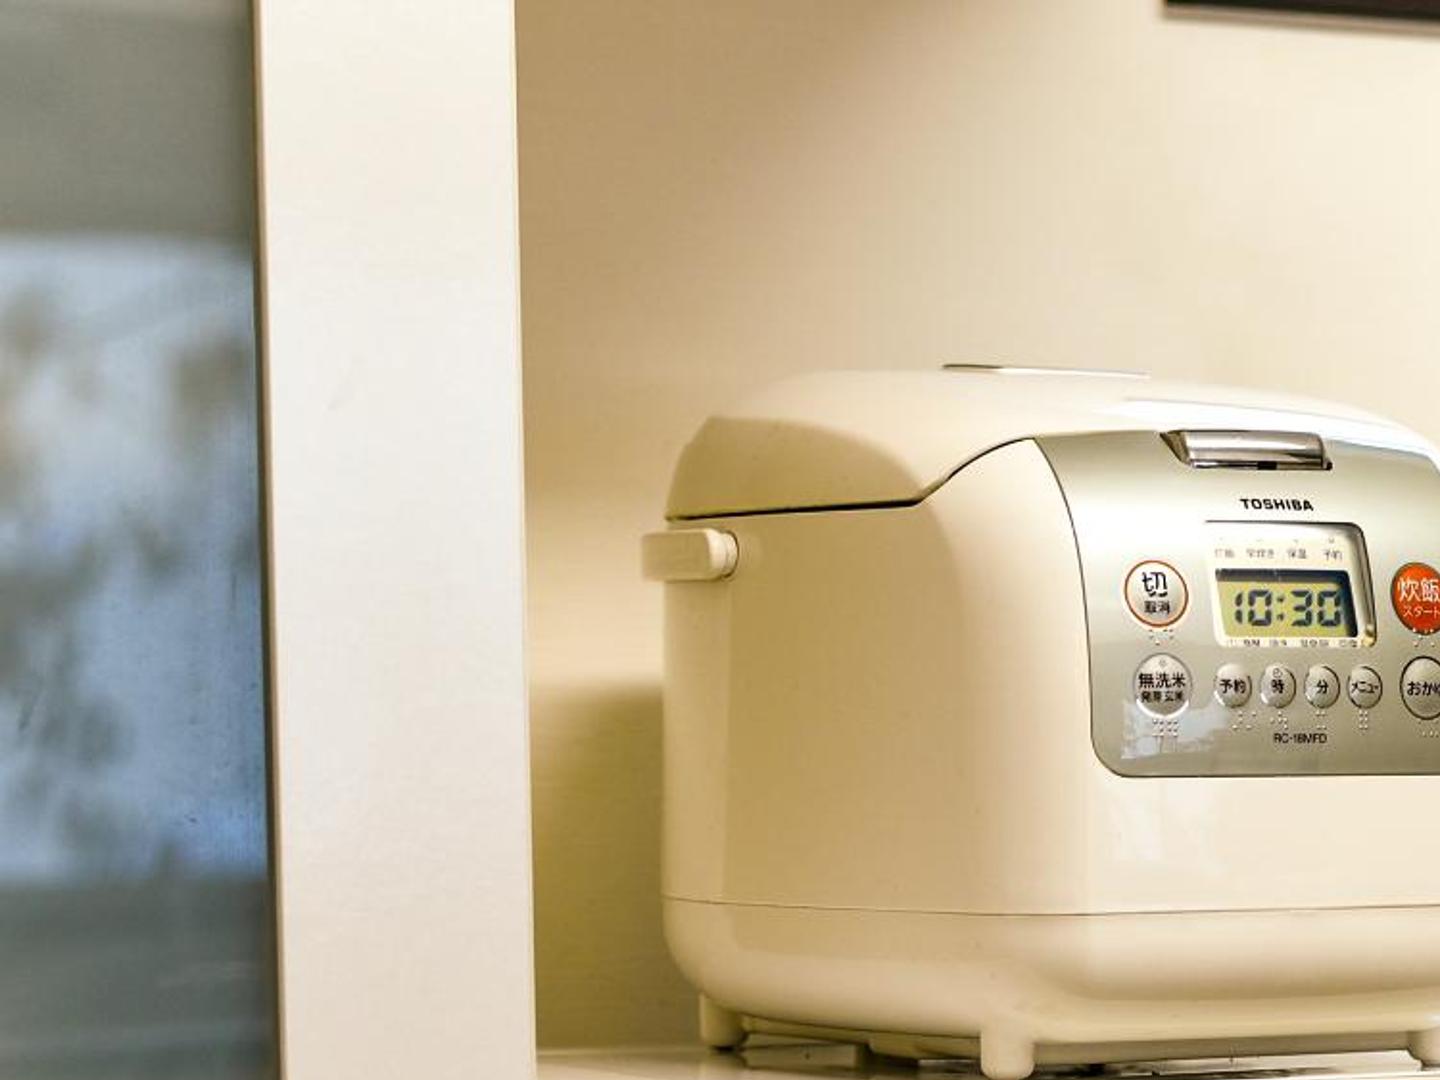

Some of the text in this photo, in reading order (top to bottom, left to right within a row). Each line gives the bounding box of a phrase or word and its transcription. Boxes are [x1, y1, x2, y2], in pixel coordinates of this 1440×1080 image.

[1240, 498, 1314, 512] TOSHIBA
[1141, 571, 1168, 598] 切
[1144, 601, 1171, 615] 取消
[1234, 589, 1342, 627] 10:30
[1402, 604, 1440, 618] スタート
[1138, 672, 1186, 688] 無洗米
[1219, 679, 1246, 694] 予約
[1271, 679, 1284, 694] 時
[1316, 679, 1329, 694] 分
[1351, 681, 1379, 694] メニュー
